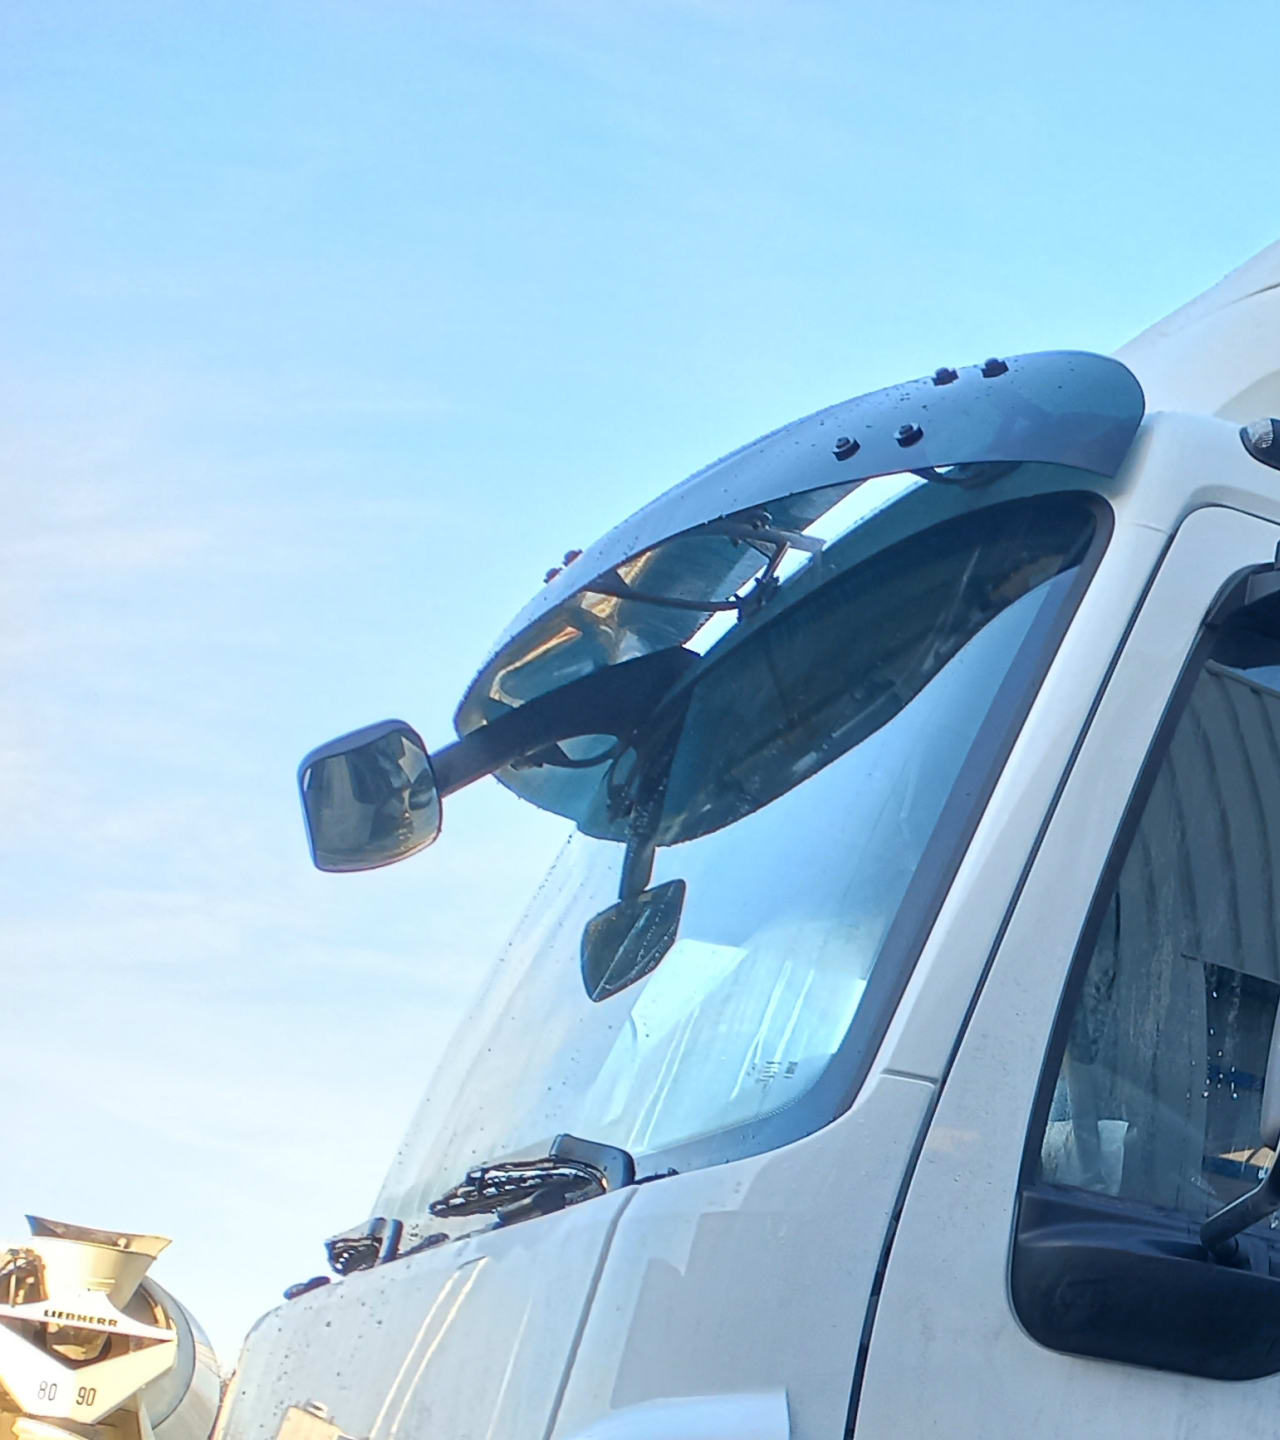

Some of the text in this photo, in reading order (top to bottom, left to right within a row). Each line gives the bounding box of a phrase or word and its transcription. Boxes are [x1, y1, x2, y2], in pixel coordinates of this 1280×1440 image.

[44, 1309, 118, 1327] LIEBHERR
[38, 1381, 57, 1401] 80
[76, 1386, 96, 1406] 90
